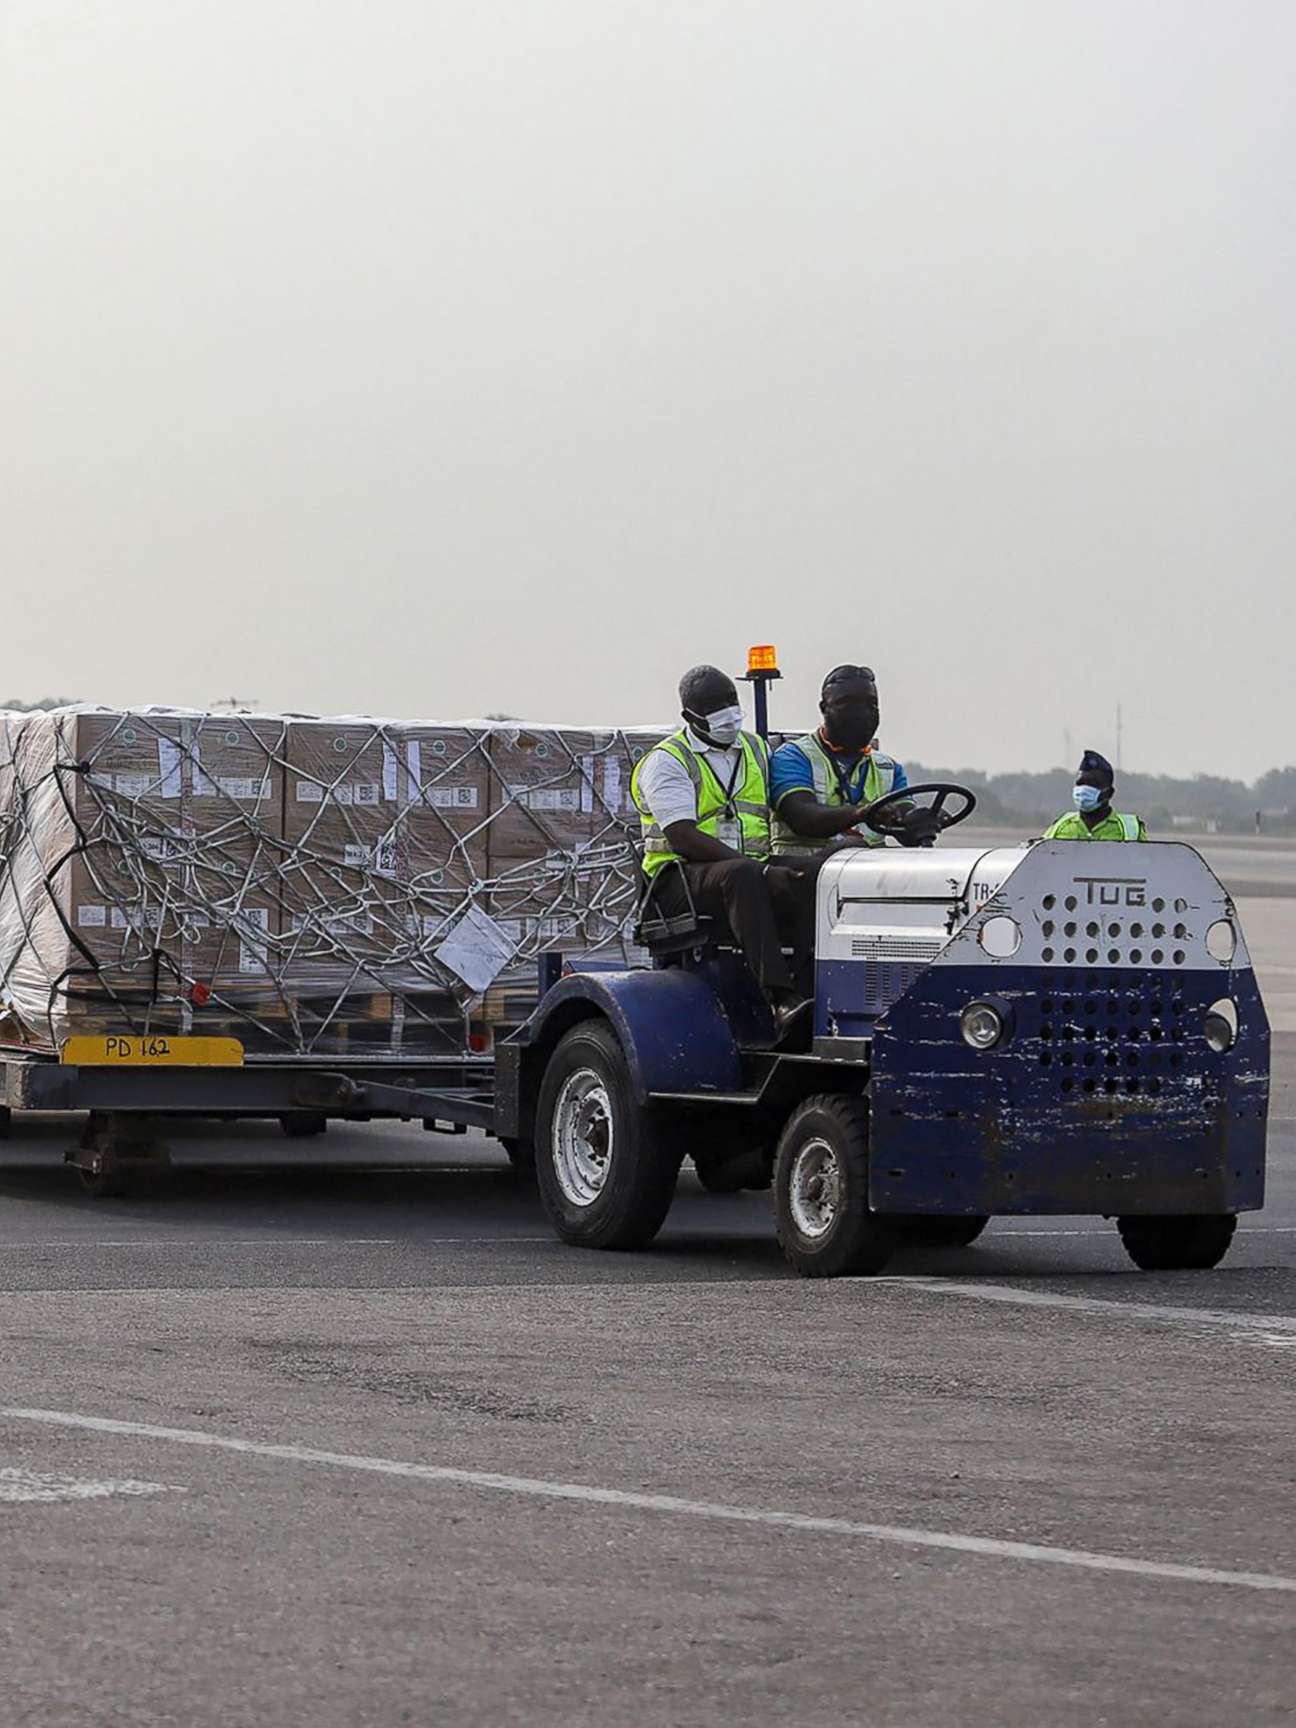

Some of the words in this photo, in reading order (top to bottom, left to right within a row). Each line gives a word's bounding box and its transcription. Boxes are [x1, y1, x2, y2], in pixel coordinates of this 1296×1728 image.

[973, 883, 1000, 900] TR-
[1073, 877, 1146, 906] TUG
[106, 1037, 131, 1056] PD
[141, 1039, 170, 1056] 162
